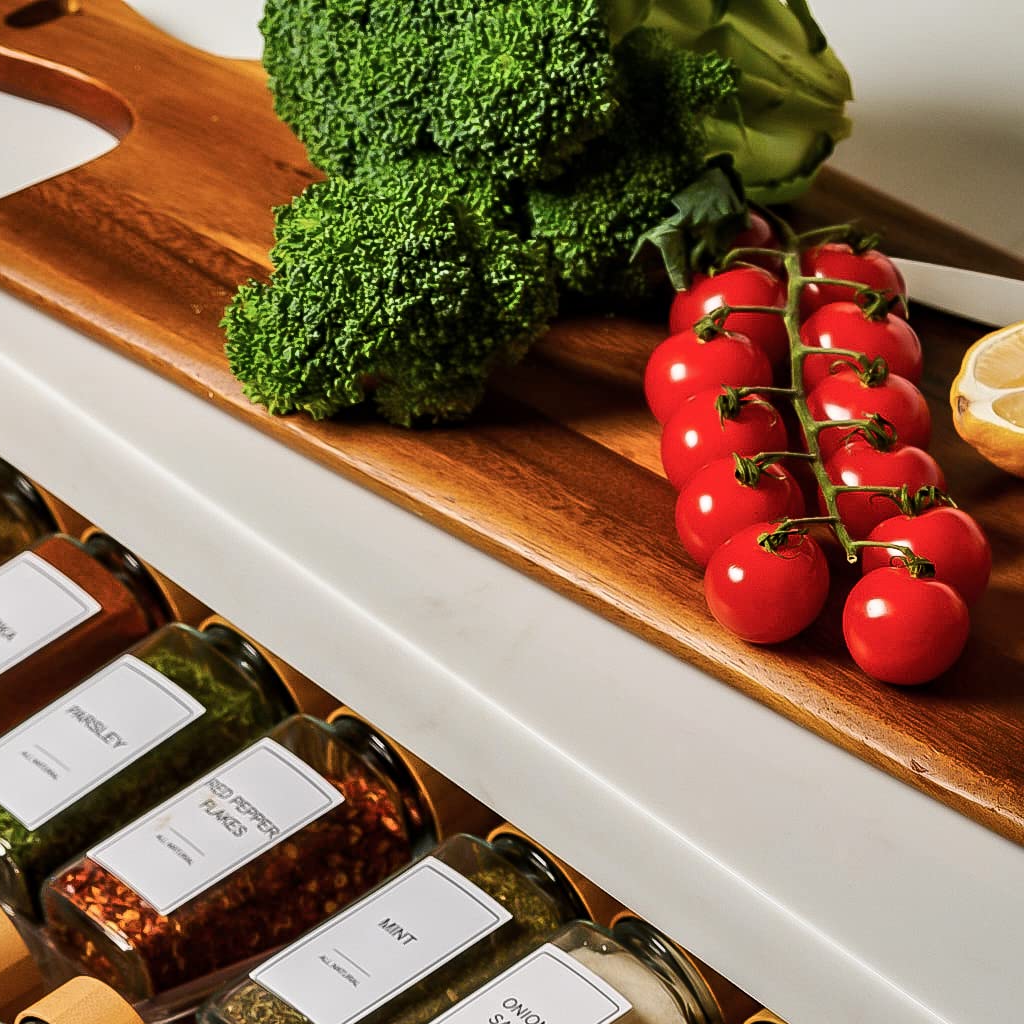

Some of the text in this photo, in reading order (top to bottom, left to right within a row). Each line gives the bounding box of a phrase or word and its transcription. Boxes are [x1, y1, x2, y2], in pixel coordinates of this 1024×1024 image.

[66, 705, 127, 749] PARSLEY
[200, 798, 247, 838] FLAKES
[205, 777, 281, 840] RED PEPPER
[378, 917, 417, 946] MINT
